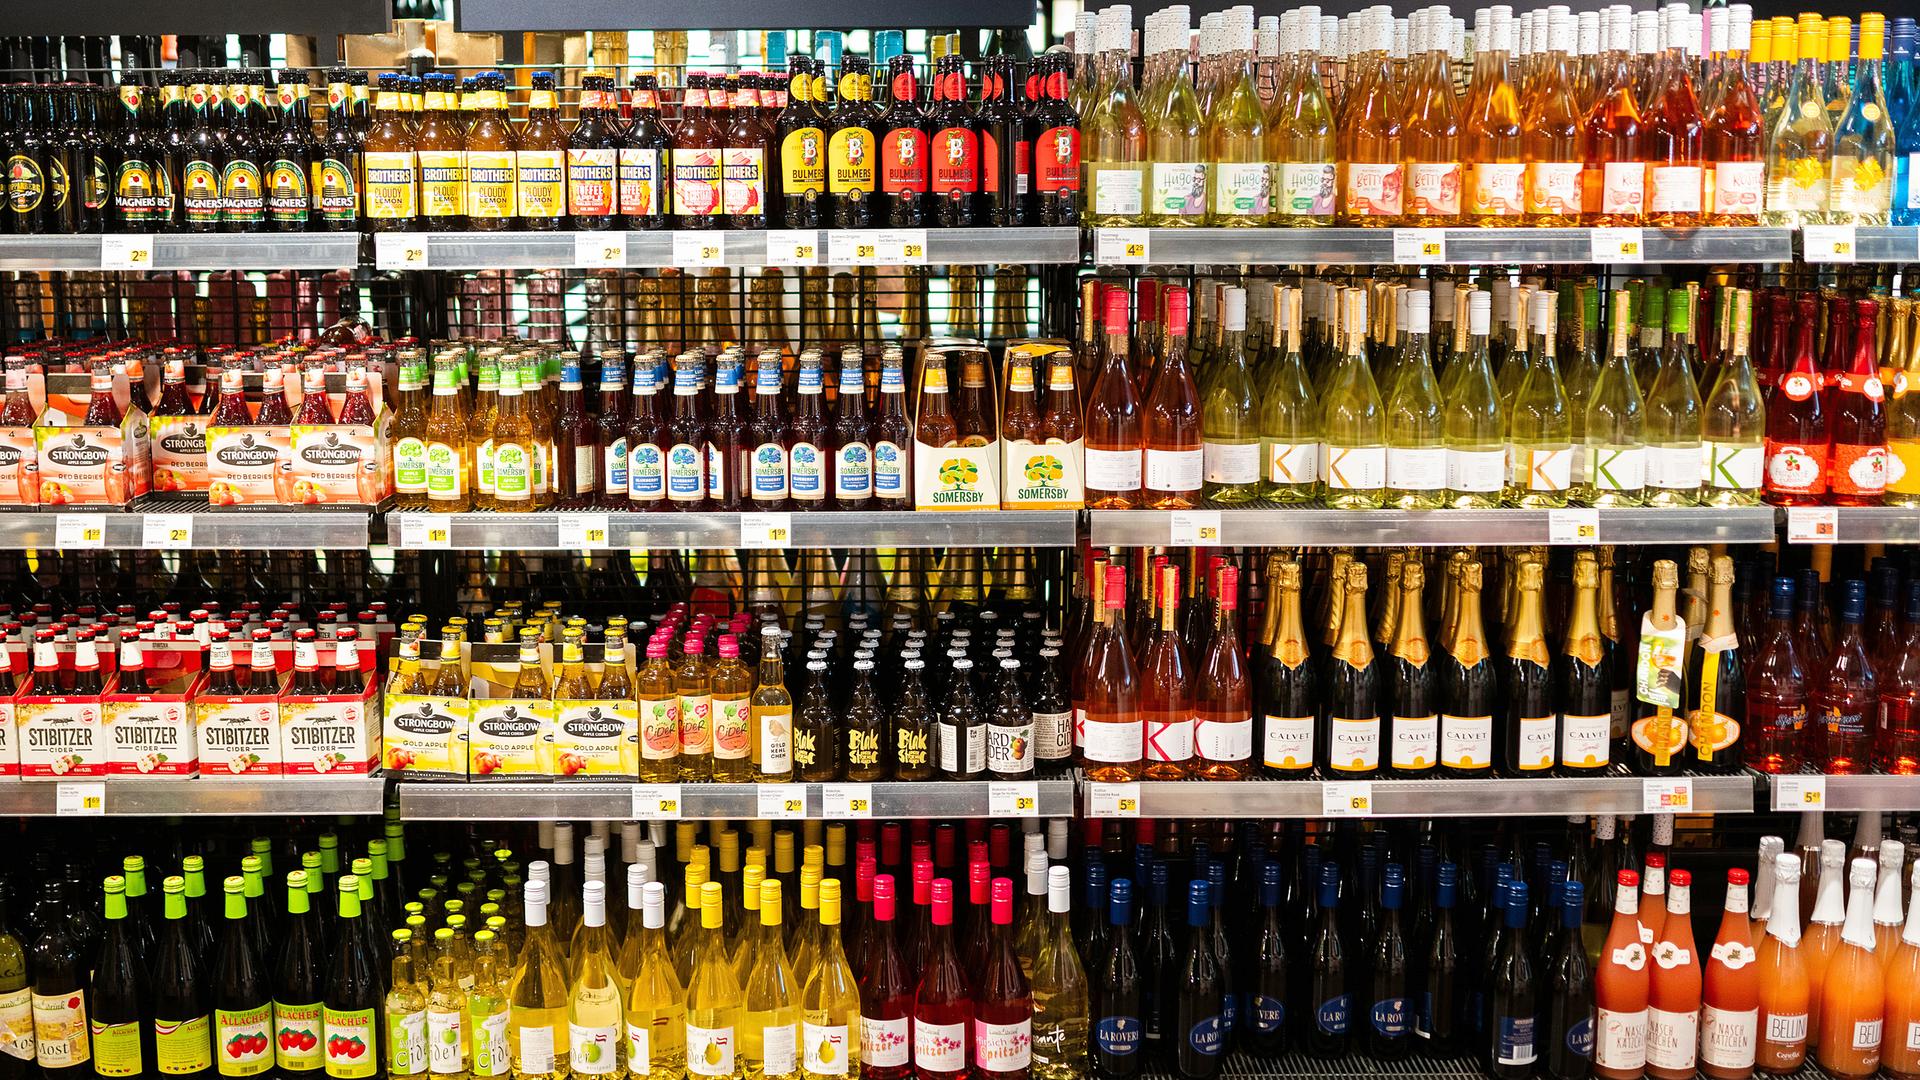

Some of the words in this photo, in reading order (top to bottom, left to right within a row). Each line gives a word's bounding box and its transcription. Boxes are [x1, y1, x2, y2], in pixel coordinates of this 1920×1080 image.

[368, 168, 411, 182] BROTHERS
[471, 168, 514, 182] BROTHERS
[520, 168, 561, 182] BROTHERS
[570, 166, 612, 179] BROTHERS
[676, 166, 719, 179] BROTHERS
[793, 168, 824, 178] BULMERS
[837, 168, 871, 178] BULMERS
[889, 168, 923, 178] BULMERS
[938, 168, 973, 178] BULMERS
[1164, 172, 1192, 187] Hugo
[1291, 173, 1320, 188] Hugo
[374, 187, 402, 198] CLOUDY
[434, 186, 458, 196] CLOUDY
[479, 186, 506, 198] CLOUDY
[526, 186, 552, 197] CLOUDY
[115, 197, 156, 207] MAGNERS
[52, 450, 108, 460] STRONGBOW
[220, 450, 278, 460] STRONGBOW
[306, 449, 361, 459] STRONGBOW
[933, 492, 984, 503] SOMERSBY
[1018, 488, 1068, 499] SOMERSBY
[1639, 646, 1652, 696] CHANDON
[398, 718, 454, 729] STRONGBOW
[1700, 681, 1714, 757] CHANDON
[484, 722, 539, 731] STRONGBOW
[568, 723, 623, 732] STRONGBOW
[29, 728, 92, 746] STIBITZER
[115, 726, 177, 744] STIBITZER
[206, 727, 269, 745] STIBITZER
[291, 727, 355, 744] STIBITZER
[988, 731, 1009, 746] ARD
[1270, 732, 1309, 740] CALVET
[1338, 734, 1376, 742] CALVET
[1399, 732, 1435, 741] CALVET
[1446, 732, 1486, 740] CALVET
[220, 1011, 269, 1026] ALLACHER
[1375, 1011, 1385, 1022] LA
[1100, 1030, 1109, 1039] LA
[1718, 1024, 1744, 1036] NASCH
[980, 1043, 1024, 1060] Spritzer
